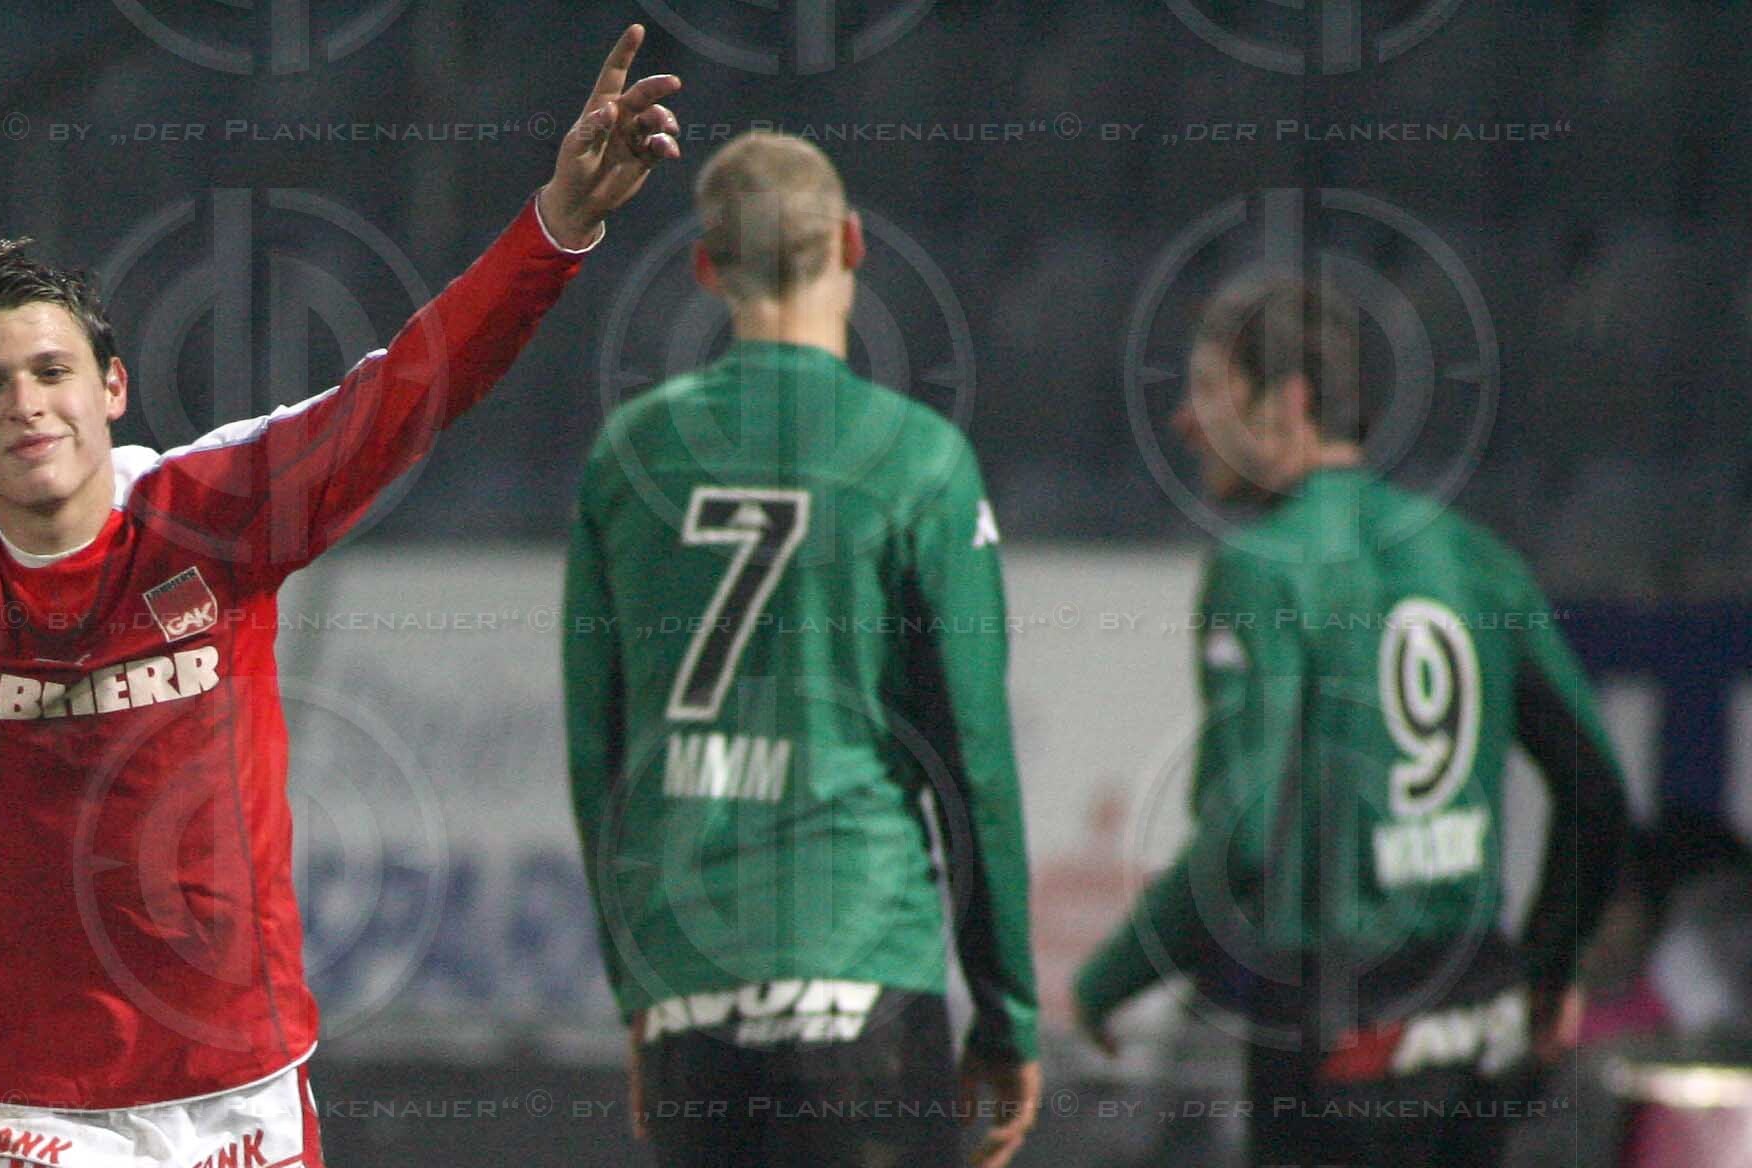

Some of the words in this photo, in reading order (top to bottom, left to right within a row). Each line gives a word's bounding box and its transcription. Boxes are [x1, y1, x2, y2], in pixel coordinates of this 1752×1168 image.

[166, 602, 214, 636] GAK
[665, 486, 811, 722] 7
[1379, 596, 1481, 816] 9
